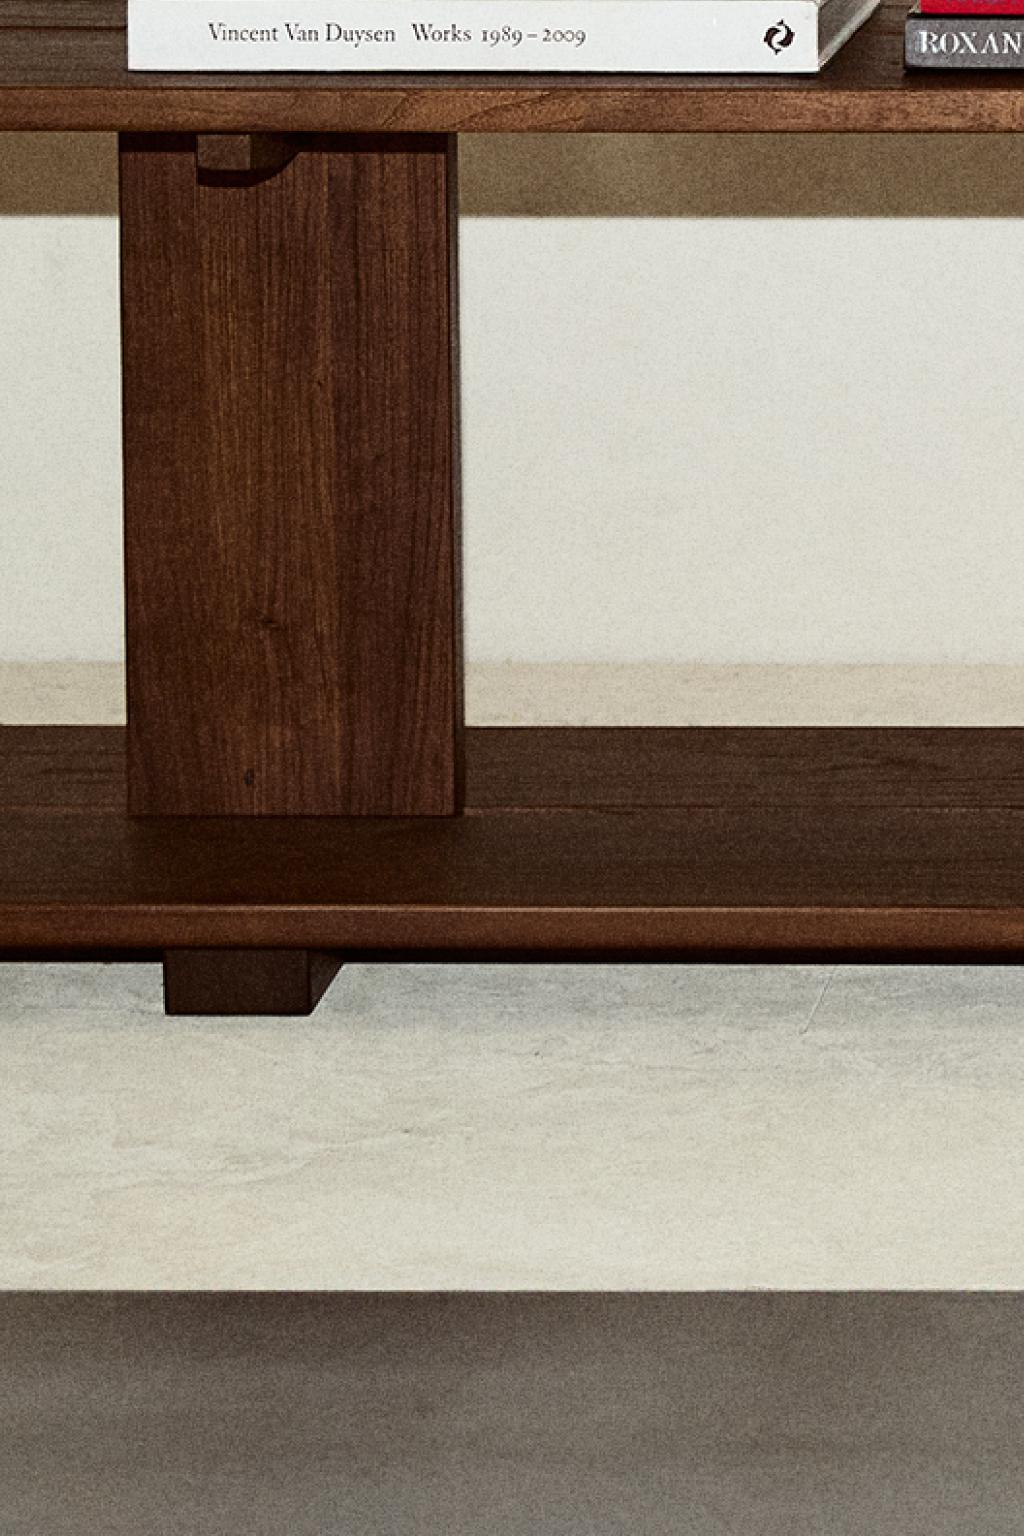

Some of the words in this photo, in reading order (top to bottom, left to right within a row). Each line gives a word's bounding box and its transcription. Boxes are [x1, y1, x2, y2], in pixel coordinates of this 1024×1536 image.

[208, 22, 279, 42] Vincent
[284, 22, 319, 42] Van
[325, 22, 396, 49] Duysen
[411, 23, 472, 43] Works
